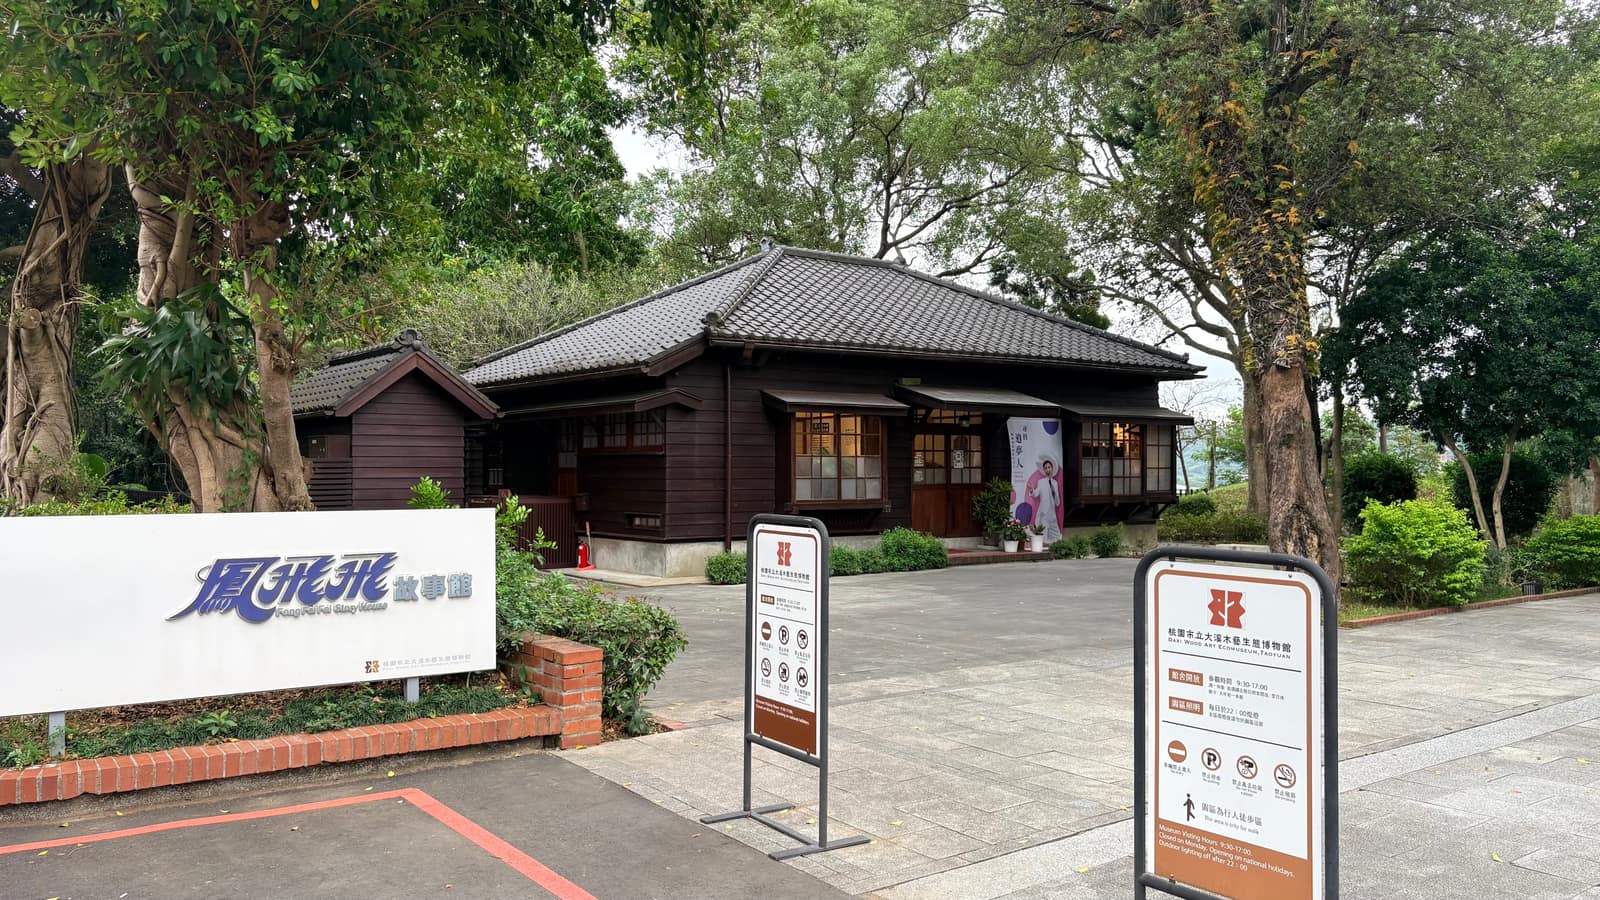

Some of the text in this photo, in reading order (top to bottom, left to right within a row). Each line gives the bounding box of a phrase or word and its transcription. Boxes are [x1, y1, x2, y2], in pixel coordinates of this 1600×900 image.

[393, 572, 473, 602] 故事館
[1168, 628, 1292, 653] 桃園市立大溪木藝生態博物館
[1236, 680, 1268, 691] 9:30-17:00
[1202, 802, 1262, 826] 園區為行人徒步區
[1159, 832, 1176, 842] Closed
[1209, 846, 1233, 860] Opening
[1243, 858, 1266, 869] national
[1159, 839, 1180, 850] Outdoor
[1181, 846, 1202, 858] lighting
[1212, 856, 1225, 864] after
